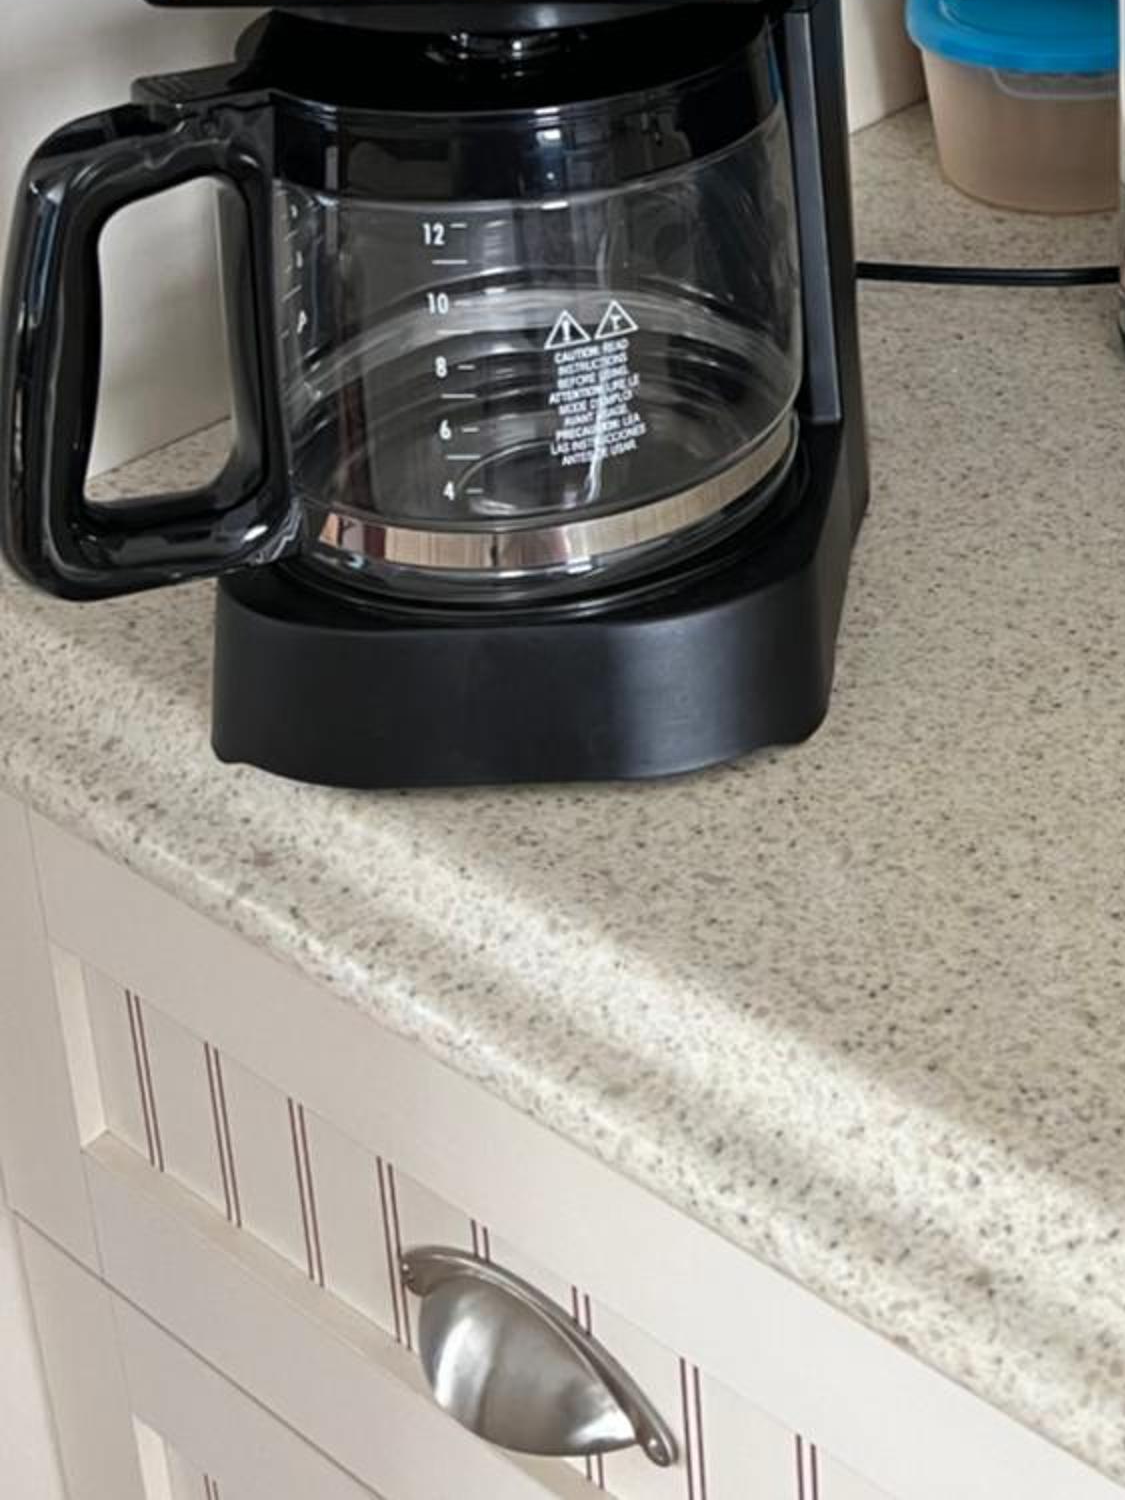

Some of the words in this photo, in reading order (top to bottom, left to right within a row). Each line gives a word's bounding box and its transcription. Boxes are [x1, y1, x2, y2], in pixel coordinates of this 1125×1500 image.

[422, 222, 446, 246] 12
[426, 291, 449, 315] 10
[434, 355, 449, 378] 8
[438, 419, 452, 441] 6
[442, 480, 456, 502] 4
